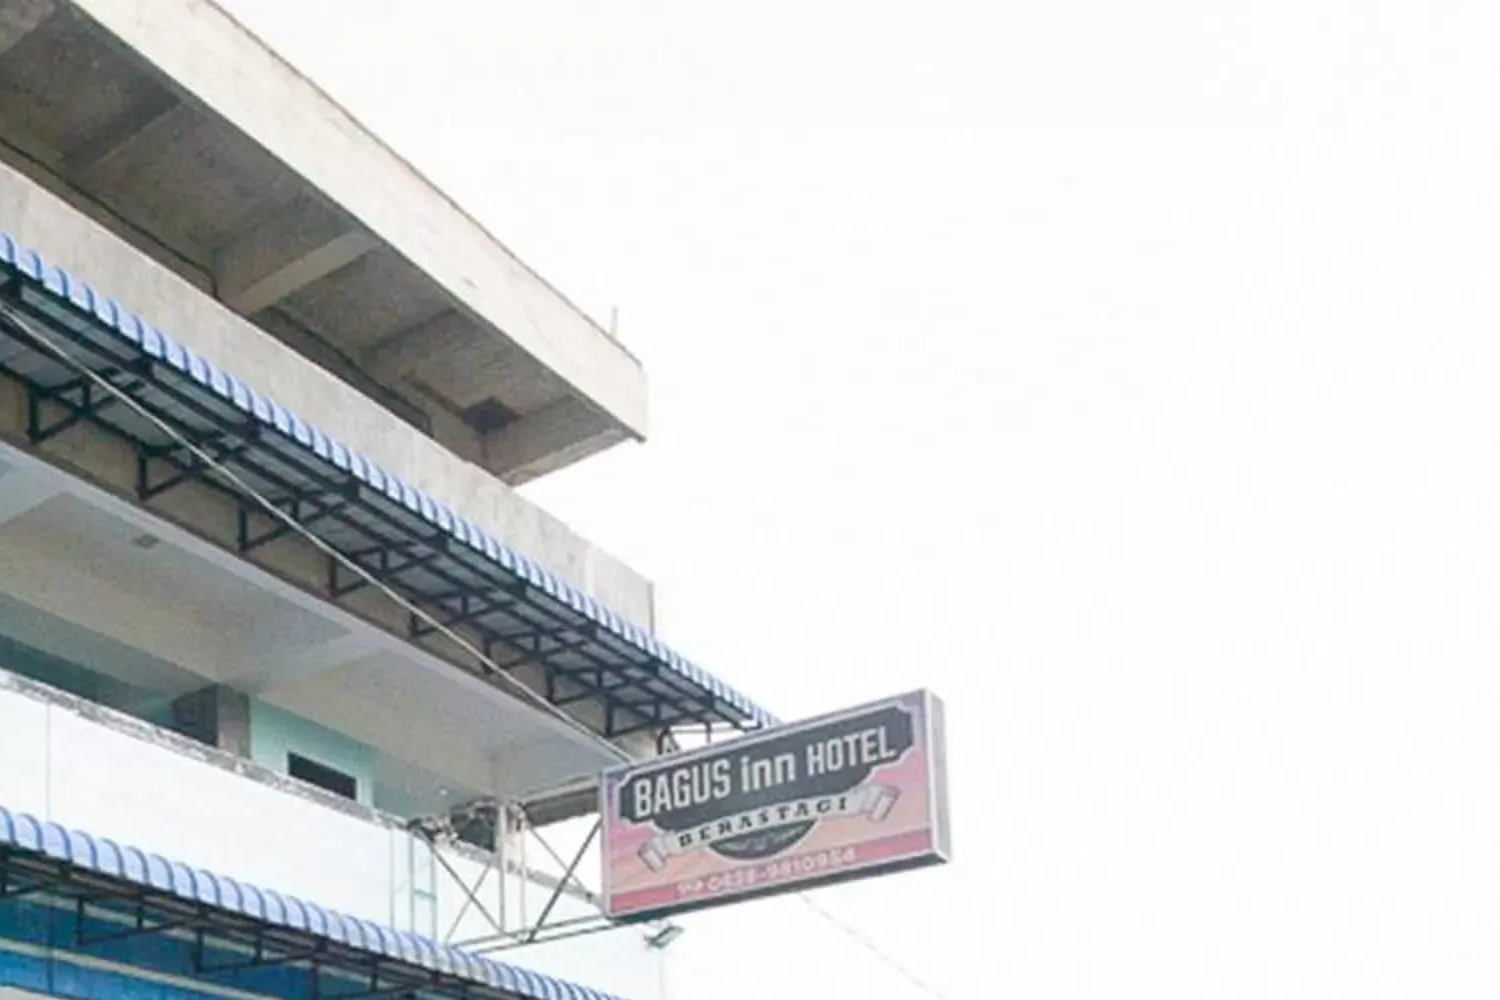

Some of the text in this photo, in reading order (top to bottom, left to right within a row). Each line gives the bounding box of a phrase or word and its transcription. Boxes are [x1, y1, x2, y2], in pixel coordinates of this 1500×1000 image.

[633, 726, 896, 818] BAGUS inn HOTEL
[678, 796, 847, 848] BERASTAGI
